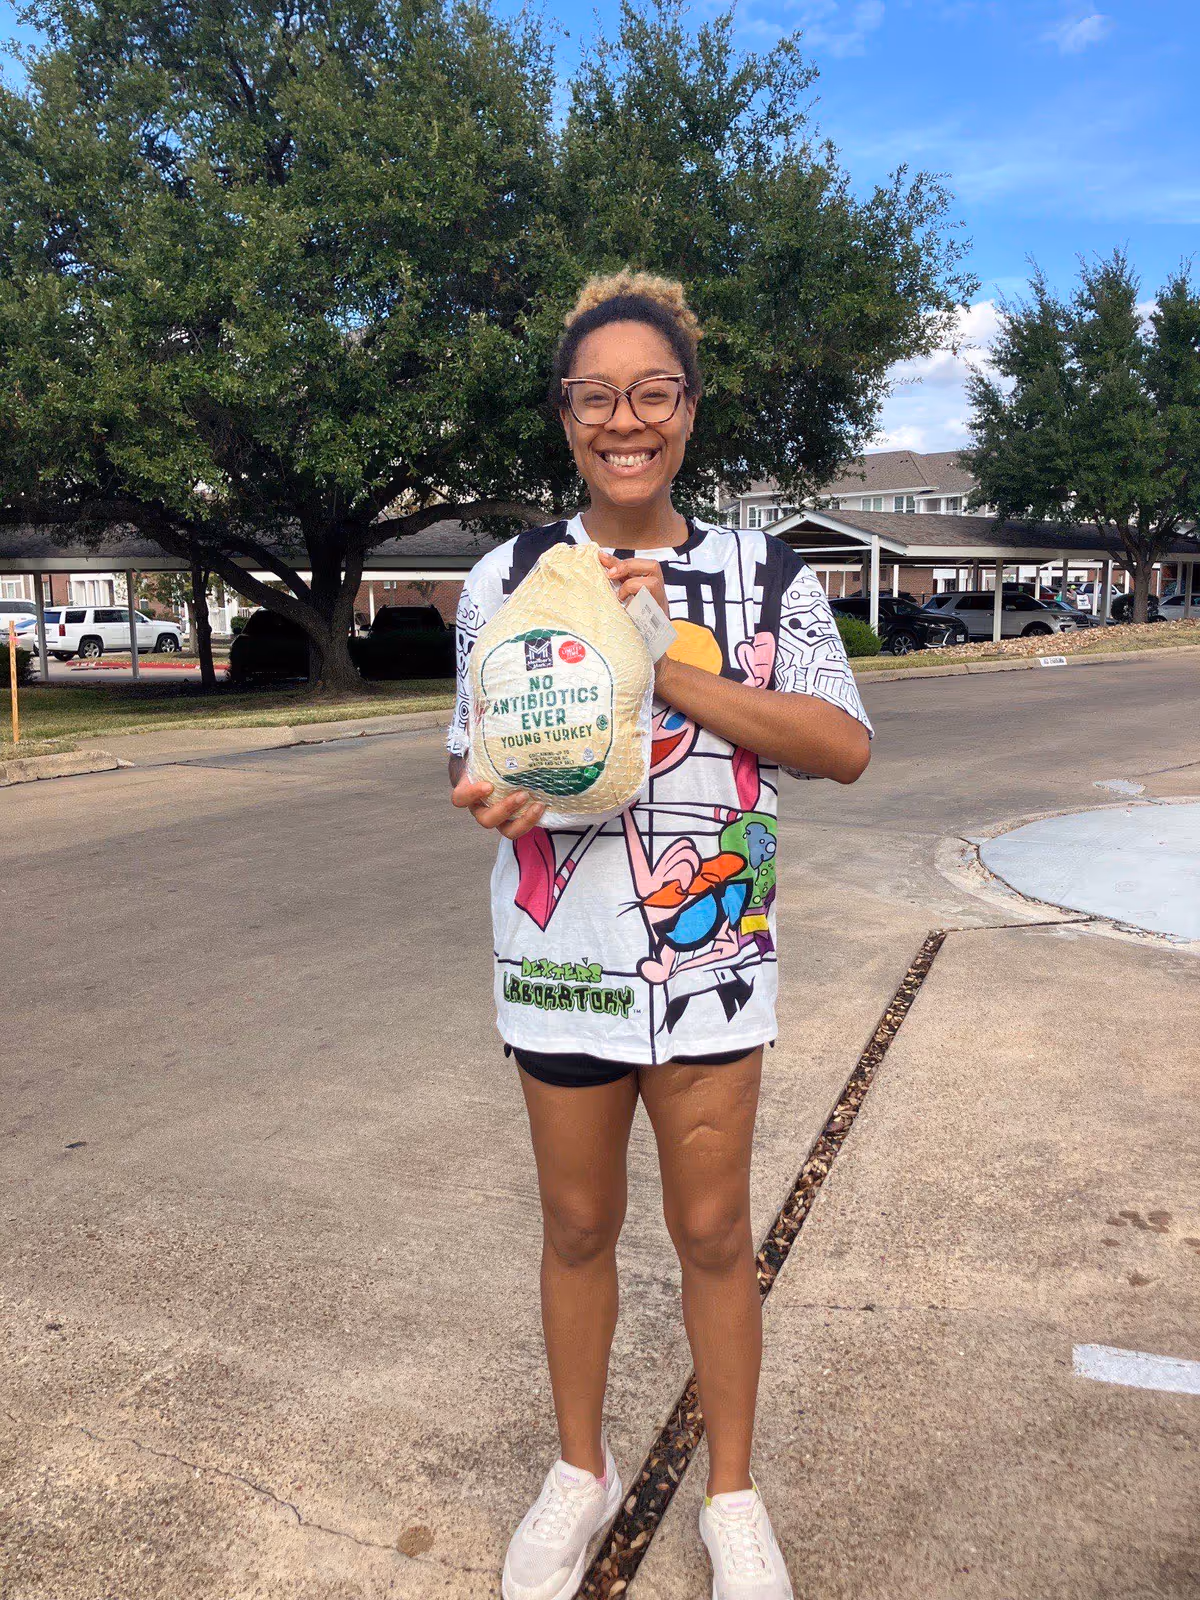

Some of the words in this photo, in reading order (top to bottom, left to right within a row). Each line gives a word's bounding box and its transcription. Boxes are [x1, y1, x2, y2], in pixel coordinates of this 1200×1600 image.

[529, 674, 553, 692] NO
[492, 686, 599, 716] ANTIBIOTICS
[521, 707, 566, 730] EVER
[501, 732, 541, 749] YOUNG
[544, 724, 592, 743] TURKEY
[521, 956, 603, 983] DEXTER'S
[503, 971, 634, 1019] LABORATORY
